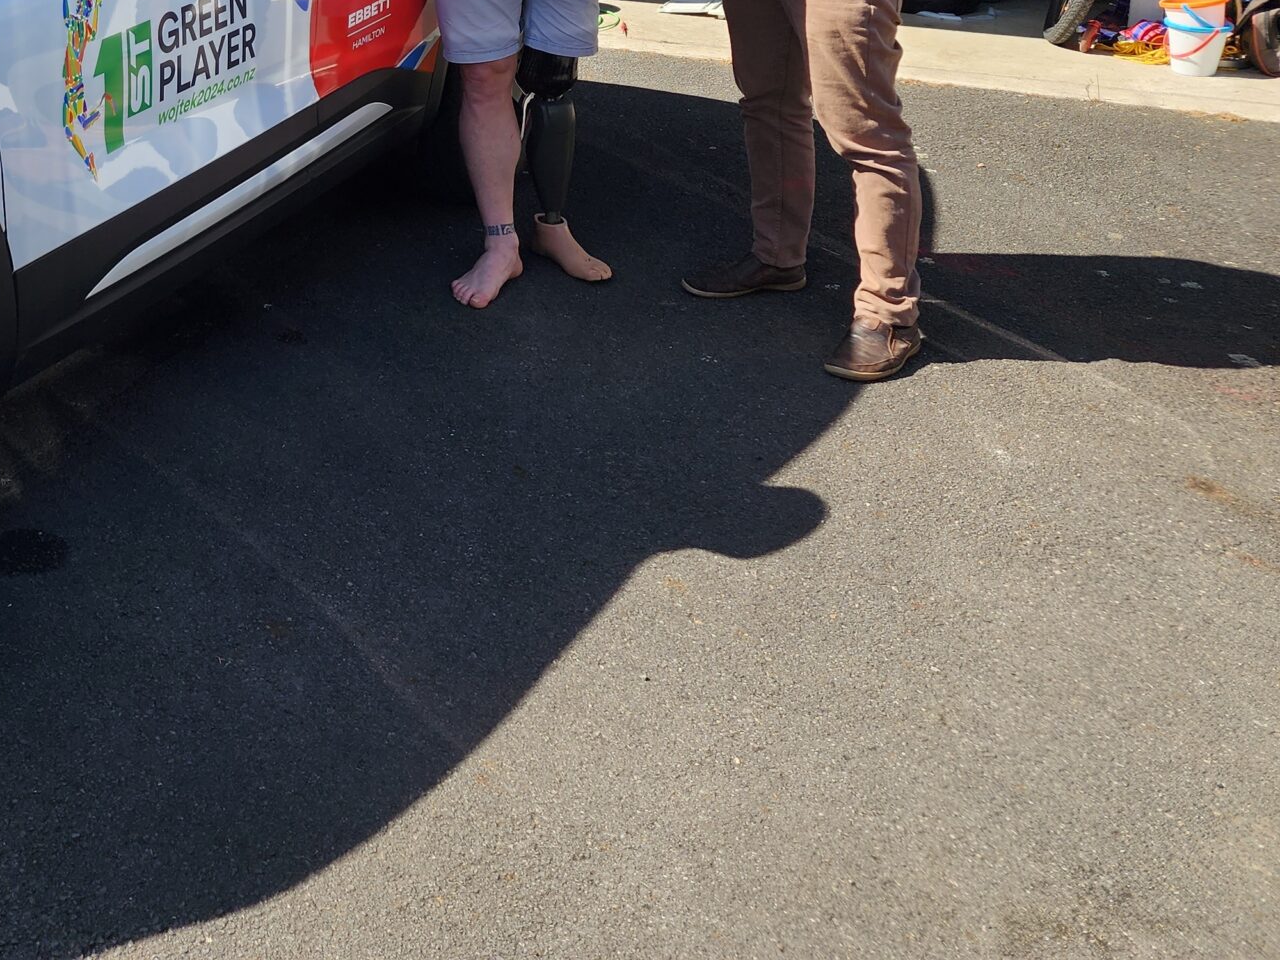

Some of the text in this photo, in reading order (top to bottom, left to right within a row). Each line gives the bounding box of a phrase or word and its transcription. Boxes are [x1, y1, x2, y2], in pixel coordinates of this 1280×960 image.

[158, 23, 257, 103] PLAYER
[352, 26, 386, 50] HAMILTON
[158, 67, 257, 126] wojtek2024.co.nz
